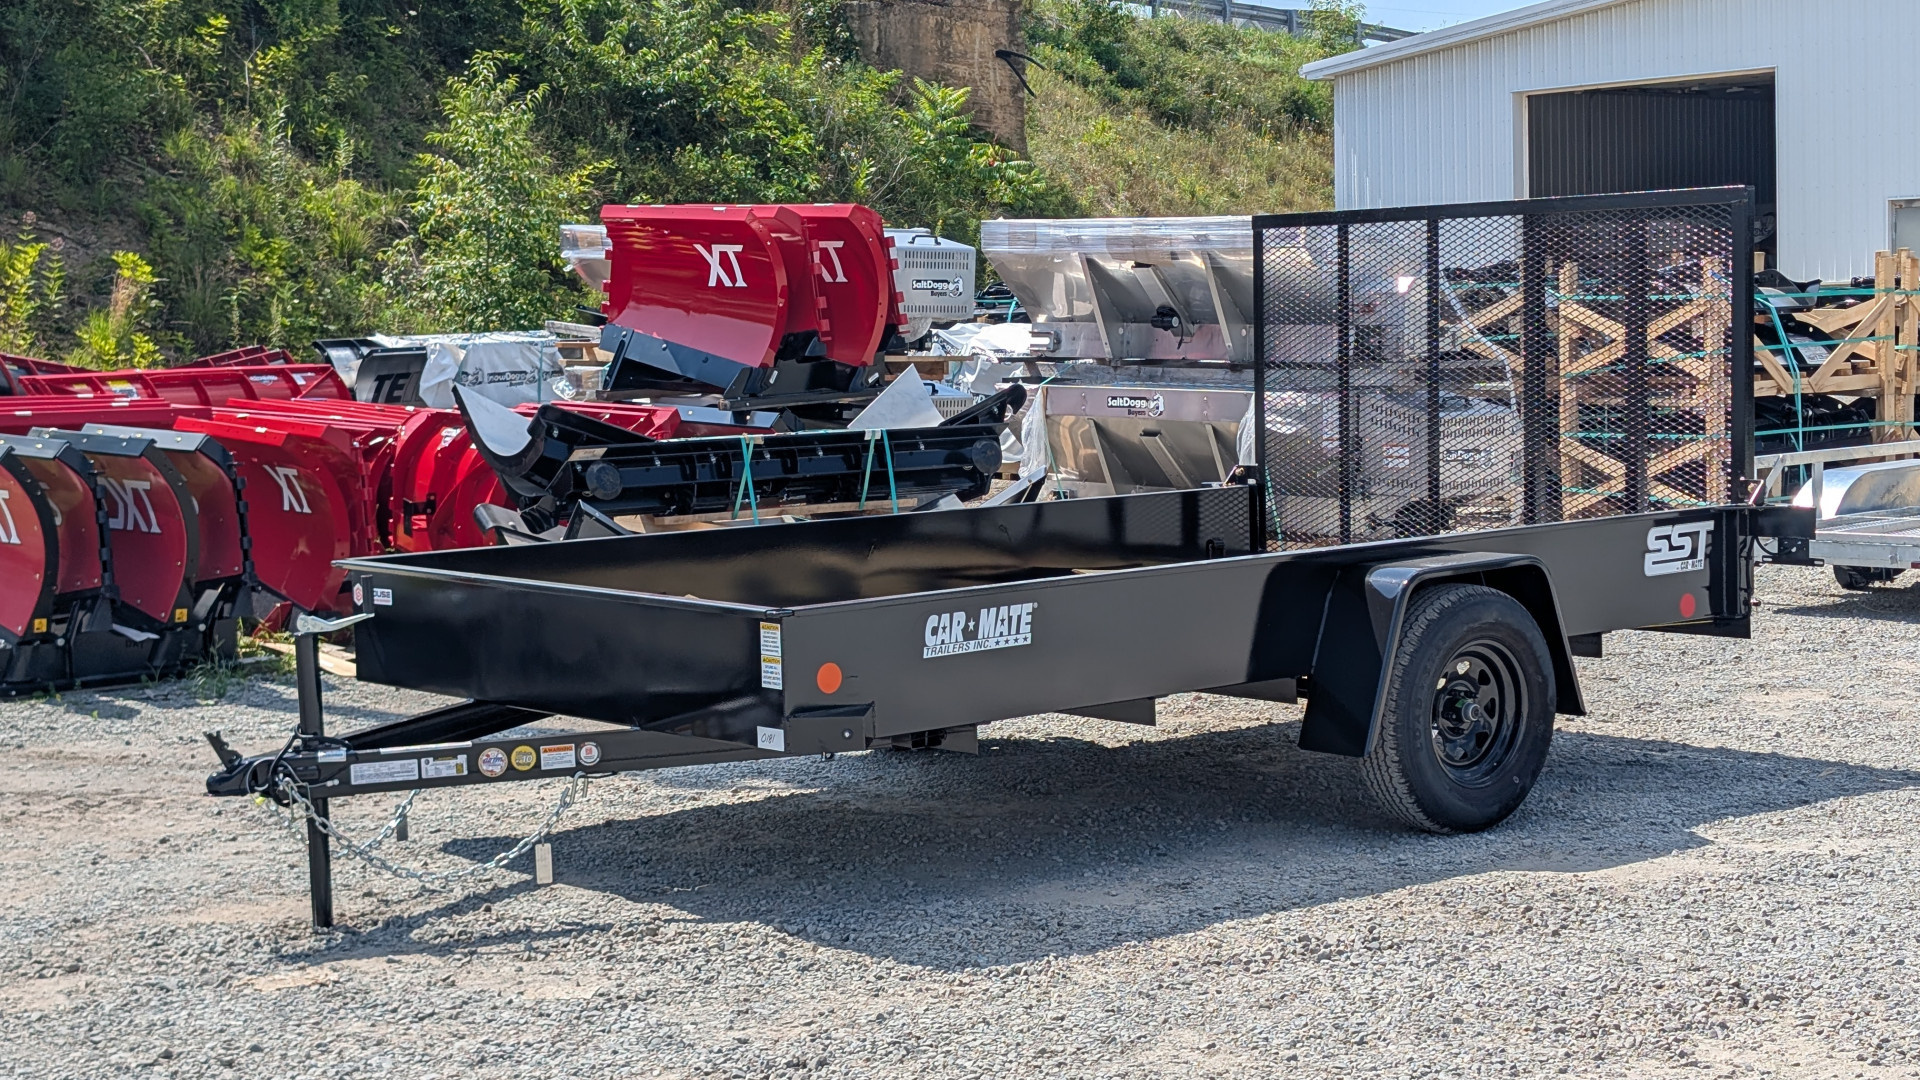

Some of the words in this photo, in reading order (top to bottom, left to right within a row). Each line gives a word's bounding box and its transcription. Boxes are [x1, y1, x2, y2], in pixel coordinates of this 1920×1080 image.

[692, 243, 748, 287] XT
[912, 280, 949, 290] SaltDogg
[1107, 397, 1147, 408] SaltDogg
[262, 464, 312, 514] XT
[1644, 520, 1714, 577] SST
[924, 611, 967, 647] CAR
[924, 641, 971, 657] TRAILERS
[973, 639, 992, 650] INC.
